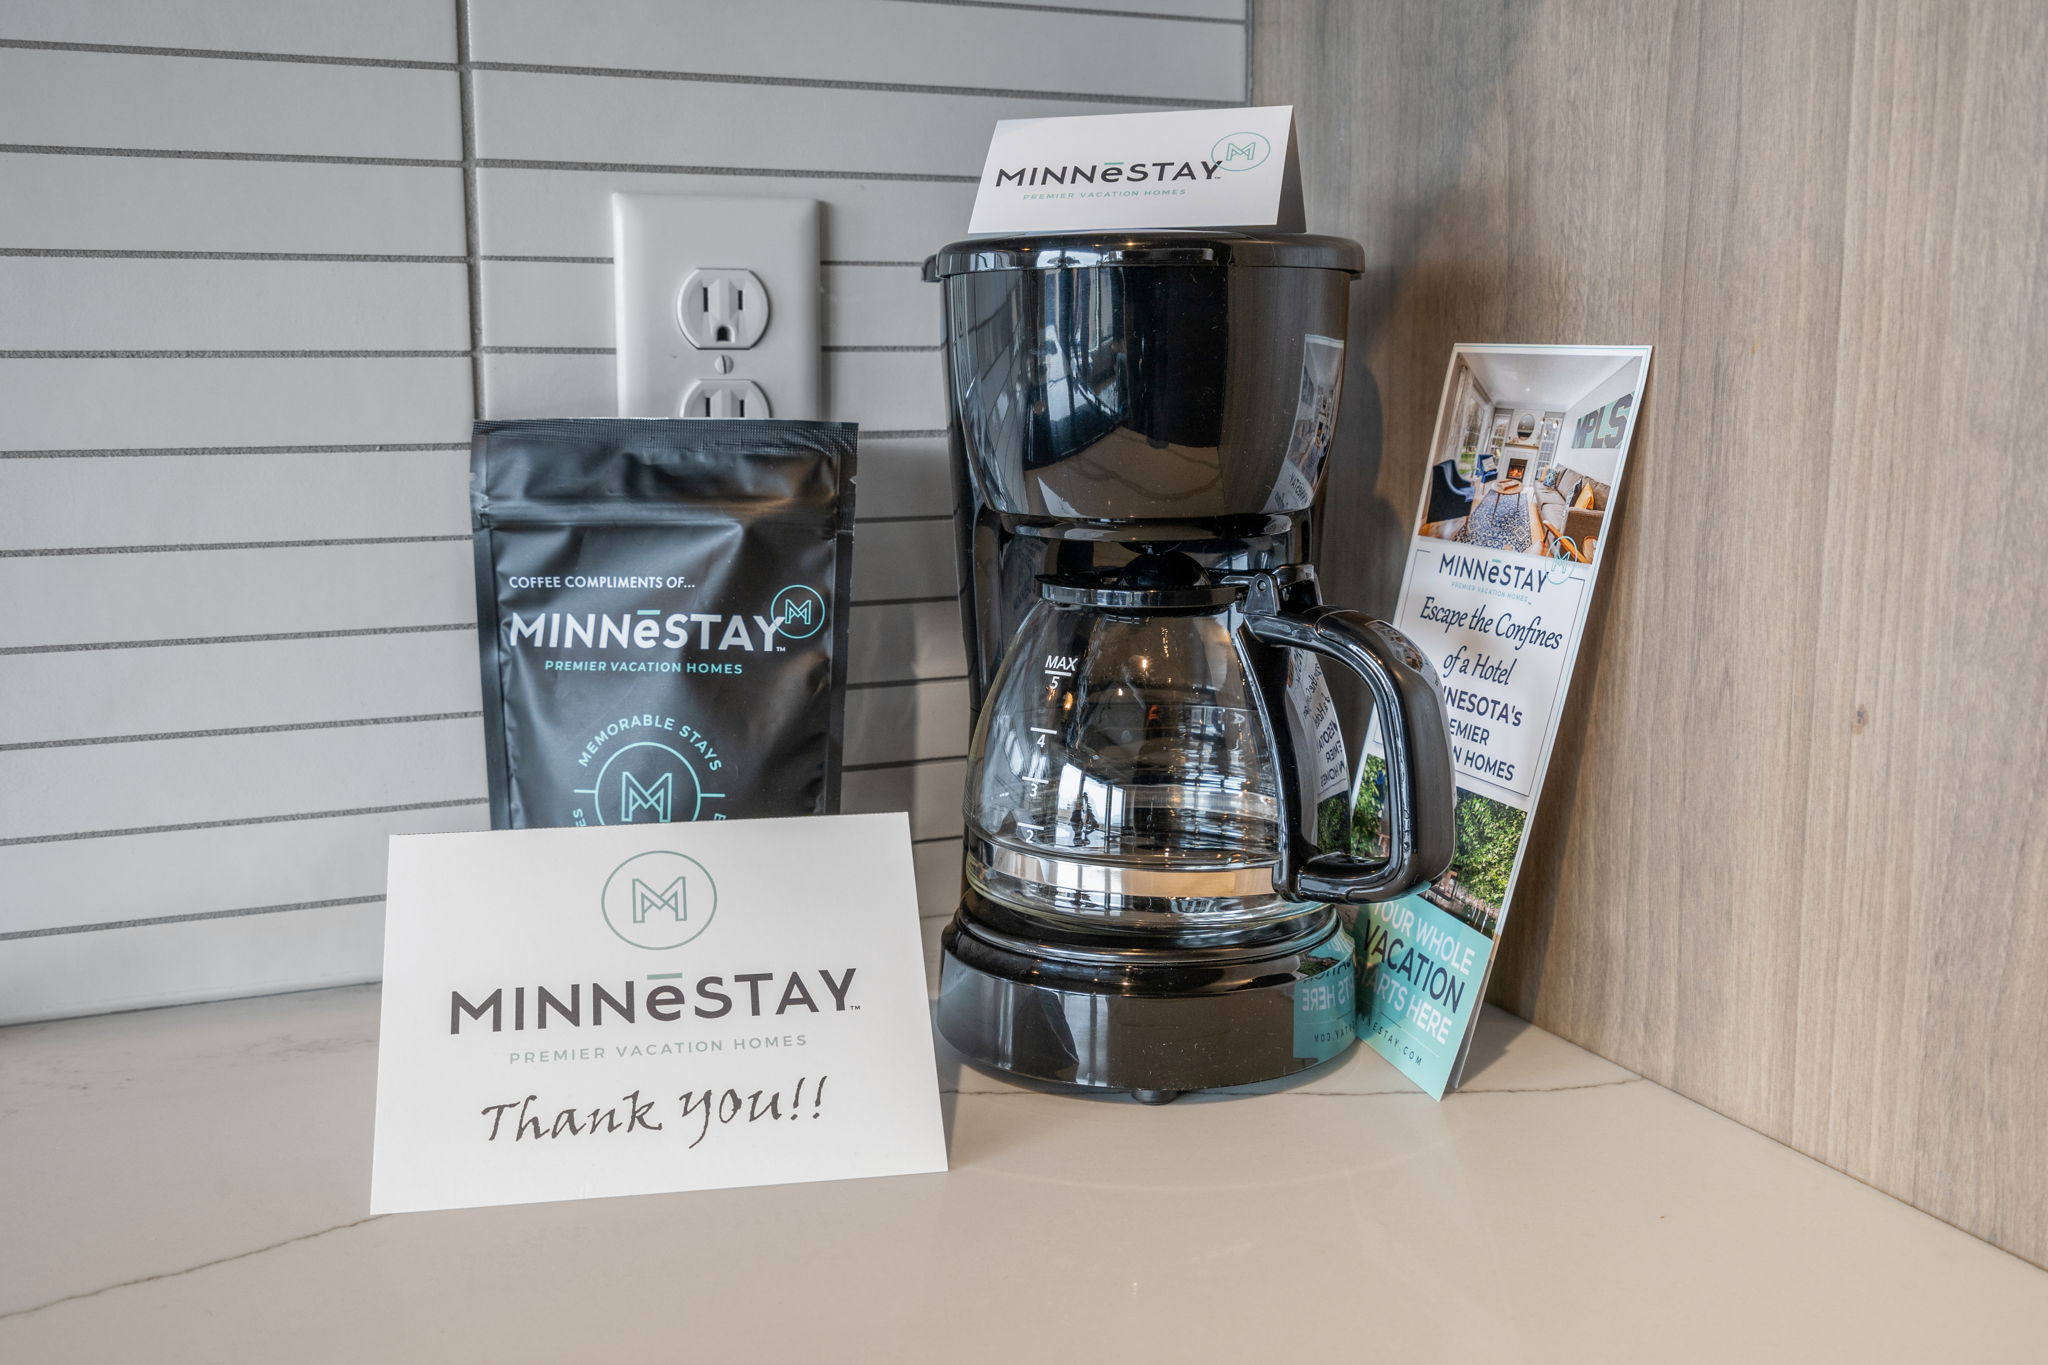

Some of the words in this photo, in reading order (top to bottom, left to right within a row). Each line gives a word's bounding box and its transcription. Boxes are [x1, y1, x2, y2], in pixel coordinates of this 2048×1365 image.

[1023, 191, 1075, 200] PREMIER
[1080, 190, 1139, 199] VACATION
[1144, 188, 1187, 196] HOMES
[509, 576, 561, 588] COFFEE
[564, 576, 662, 589] COMPLIMENTS
[666, 576, 695, 588] OF...
[1478, 586, 1505, 598] VACATION
[1419, 596, 1468, 633] Escape
[1470, 604, 1493, 633] the
[1495, 613, 1563, 650] Confines
[545, 660, 607, 672] PREMIER
[610, 661, 682, 673] VACATION
[686, 662, 743, 675] HOMES
[1045, 655, 1078, 671] MAX
[1443, 645, 1468, 678] of
[1459, 658, 1470, 673] a
[1472, 653, 1517, 685] Hotel
[1050, 676, 1060, 689] 5
[1445, 685, 1523, 727] NESOTA's
[577, 714, 675, 768] MEMORABLE
[679, 725, 722, 772] STAYS
[1037, 734, 1046, 748] 4
[1449, 718, 1490, 746] EMIER
[1464, 749, 1515, 781] HOMES
[1029, 783, 1037, 797] 3
[1025, 829, 1034, 843] 2
[1415, 918, 1475, 976] WHOLE
[1364, 919, 1465, 1014] VACATION
[1406, 994, 1453, 1044] HERE
[509, 1045, 606, 1065] PREMIER
[616, 1039, 723, 1058] VACATION
[734, 1033, 807, 1050] HOMES
[482, 1090, 662, 1143] Thank
[678, 1076, 828, 1149] you!!
